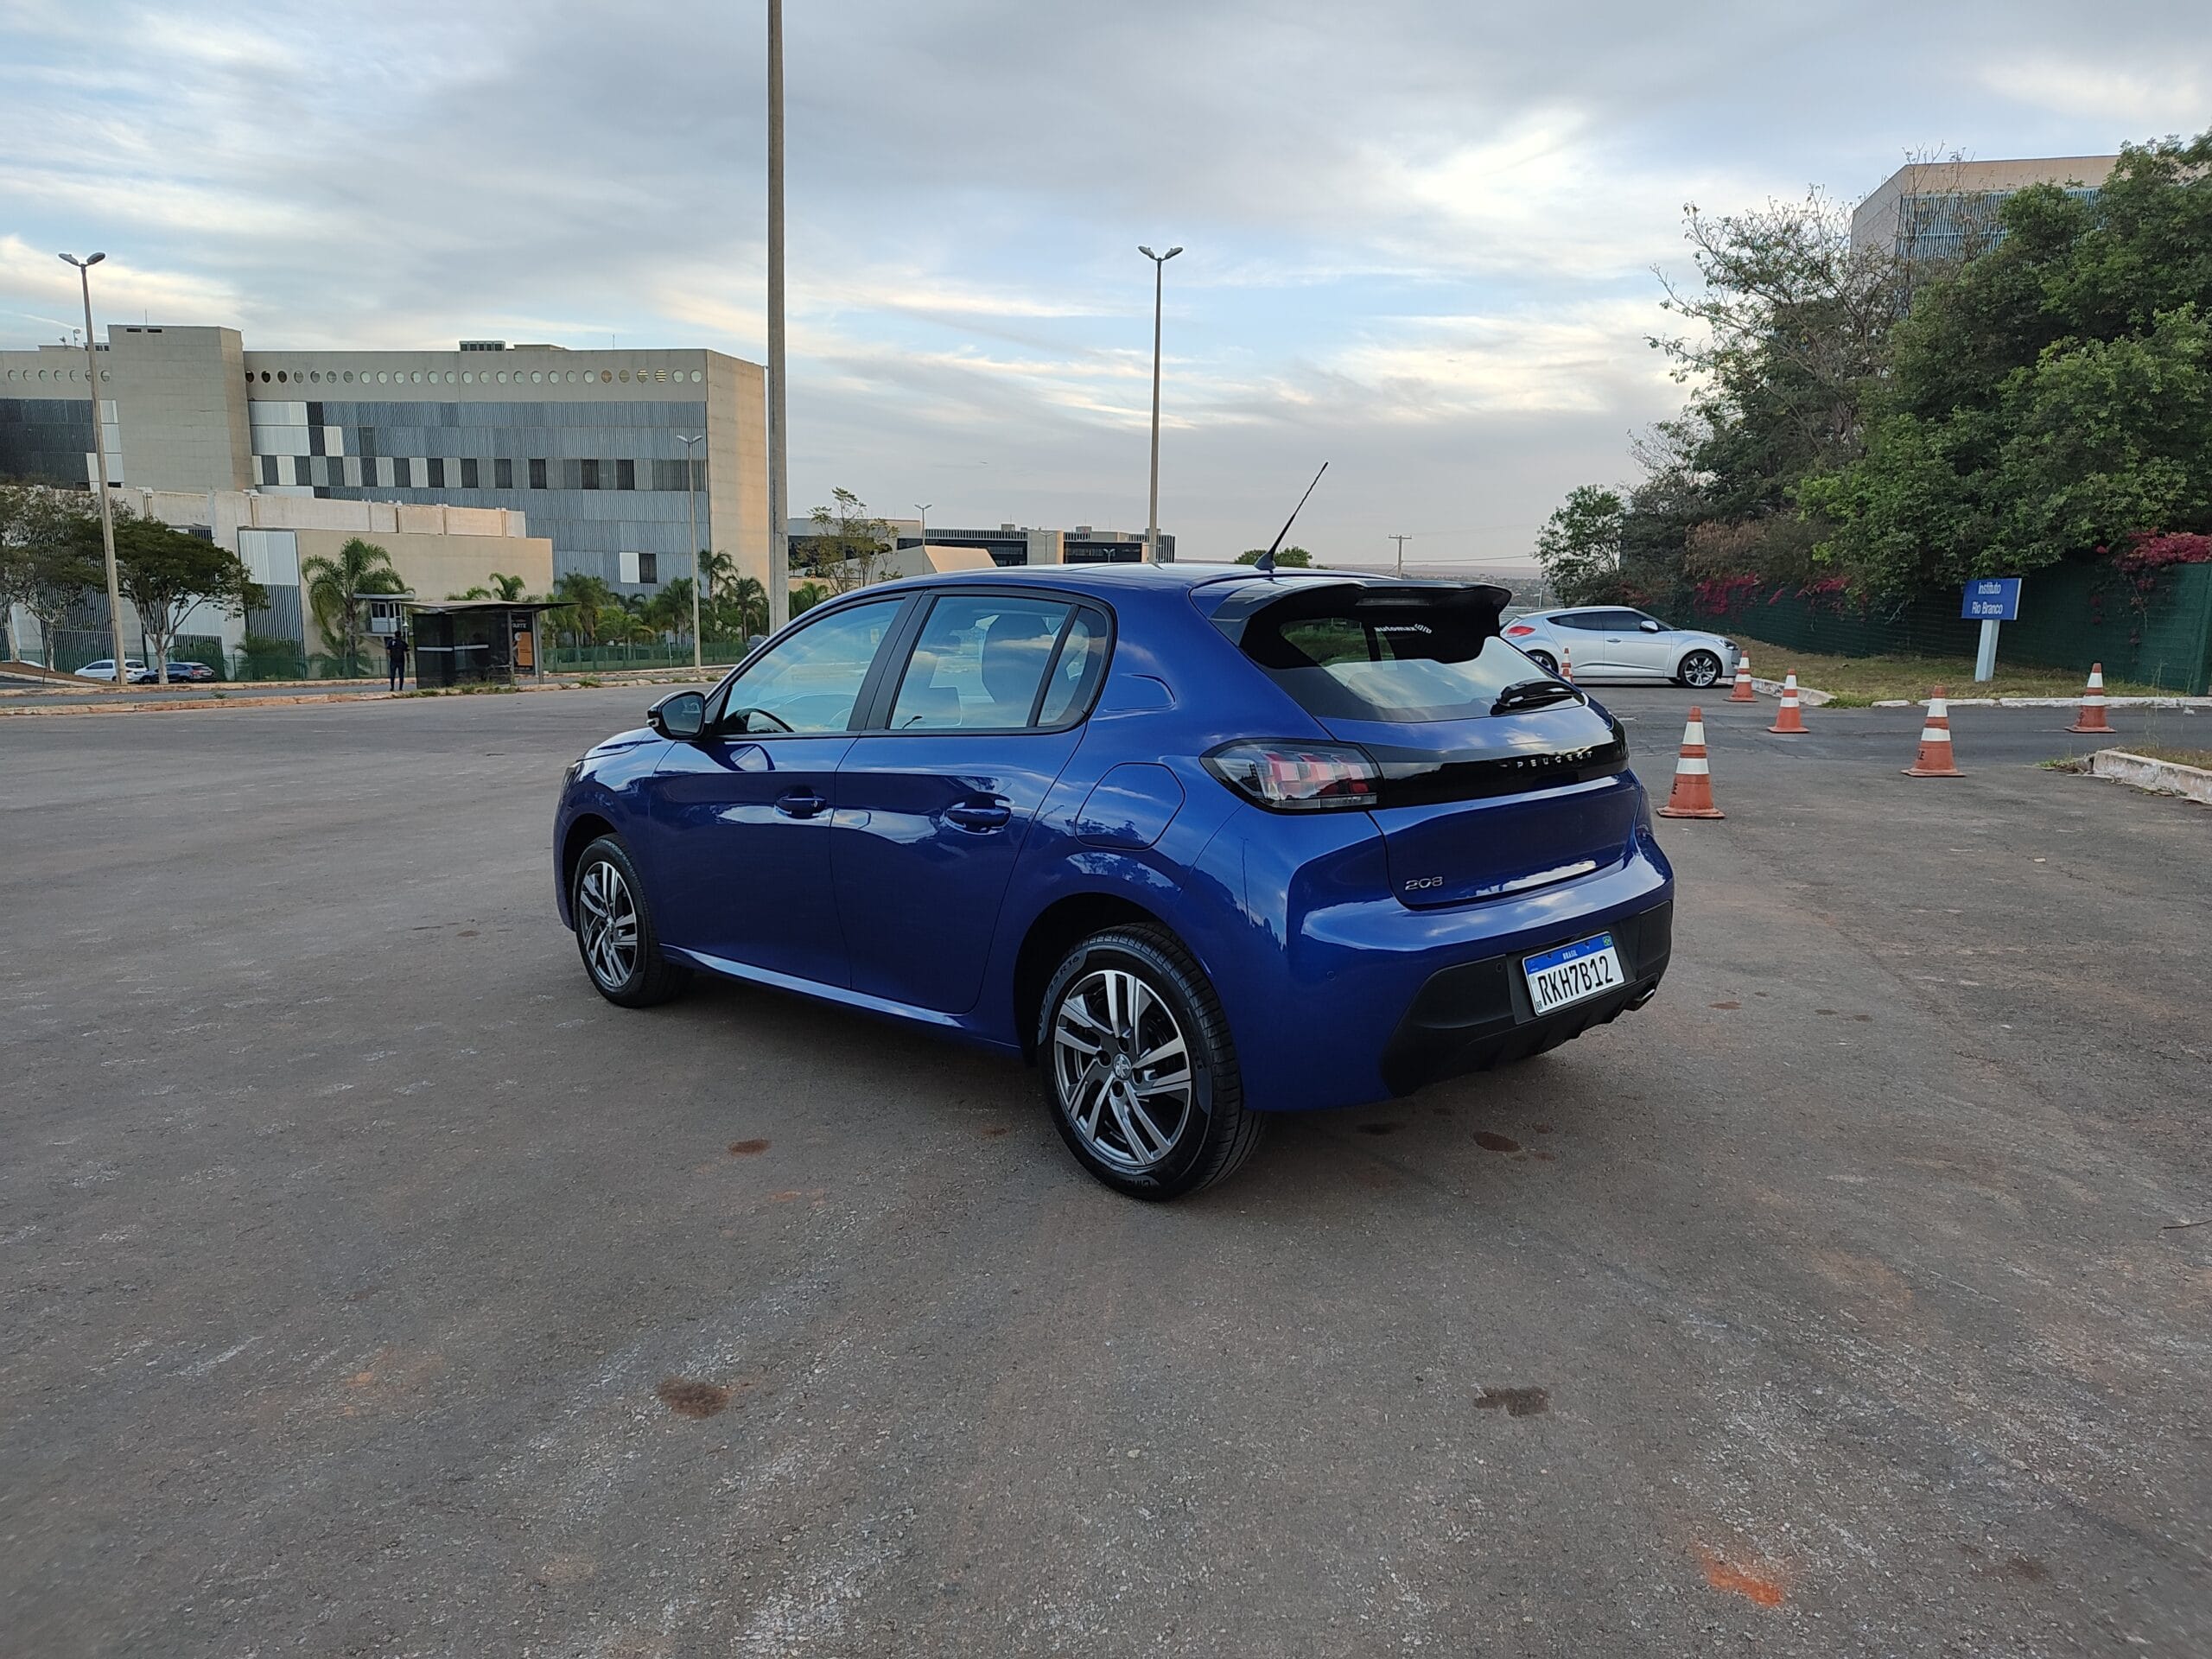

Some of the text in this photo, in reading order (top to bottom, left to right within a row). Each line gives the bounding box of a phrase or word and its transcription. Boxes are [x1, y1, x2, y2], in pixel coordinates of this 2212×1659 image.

[1978, 582, 2002, 594] Instituto
[1971, 601, 2004, 614] Rio Branco
[1516, 751, 1592, 768] PEUGEOT
[1404, 876, 1443, 891] 208
[1561, 949, 1579, 960] BRASIL
[1537, 956, 1613, 1006] RKH7B12
